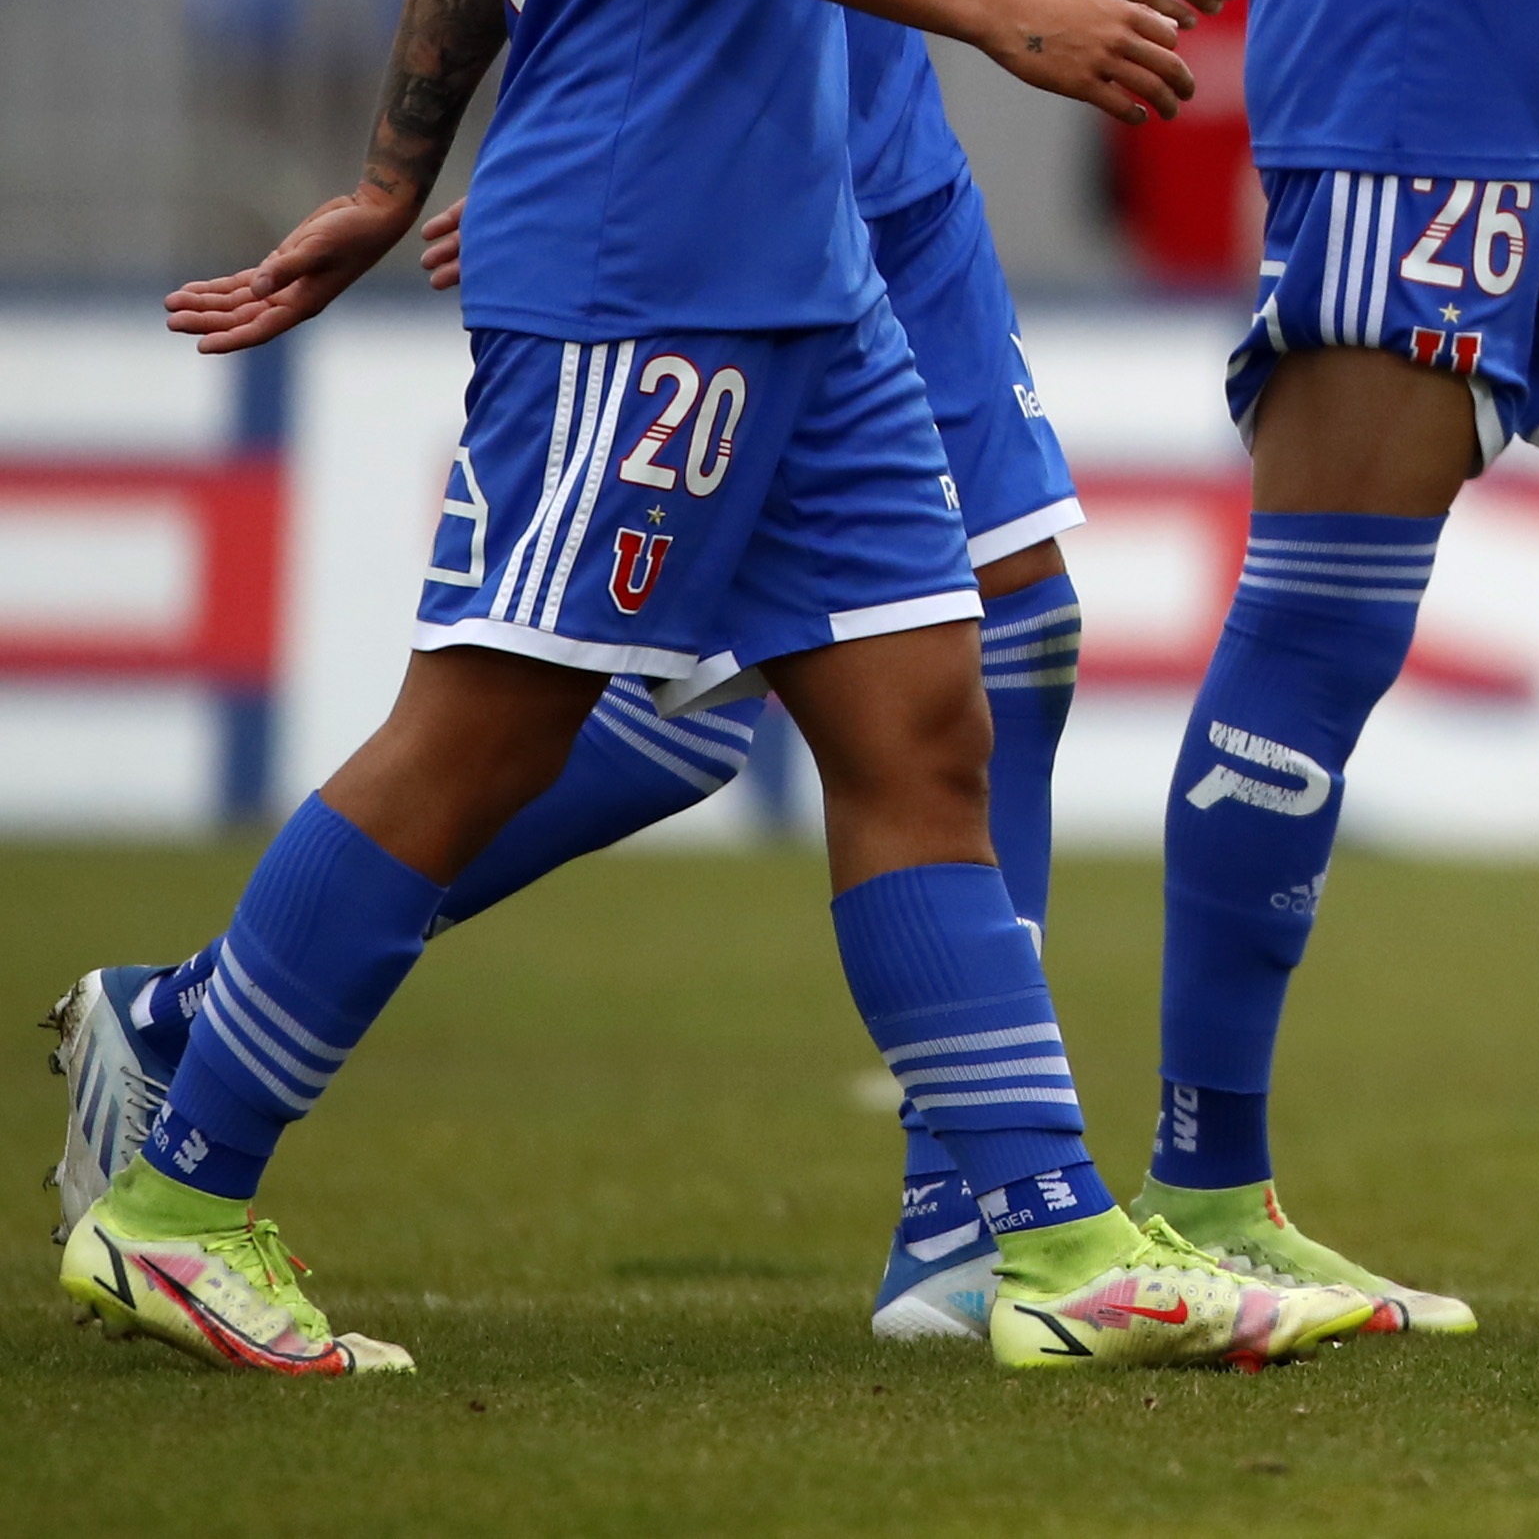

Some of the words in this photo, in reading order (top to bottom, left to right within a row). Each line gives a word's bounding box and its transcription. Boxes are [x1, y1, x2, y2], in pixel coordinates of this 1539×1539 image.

[1399, 178, 1532, 296] 26
[619, 353, 747, 498] 20
[608, 527, 673, 614] U
